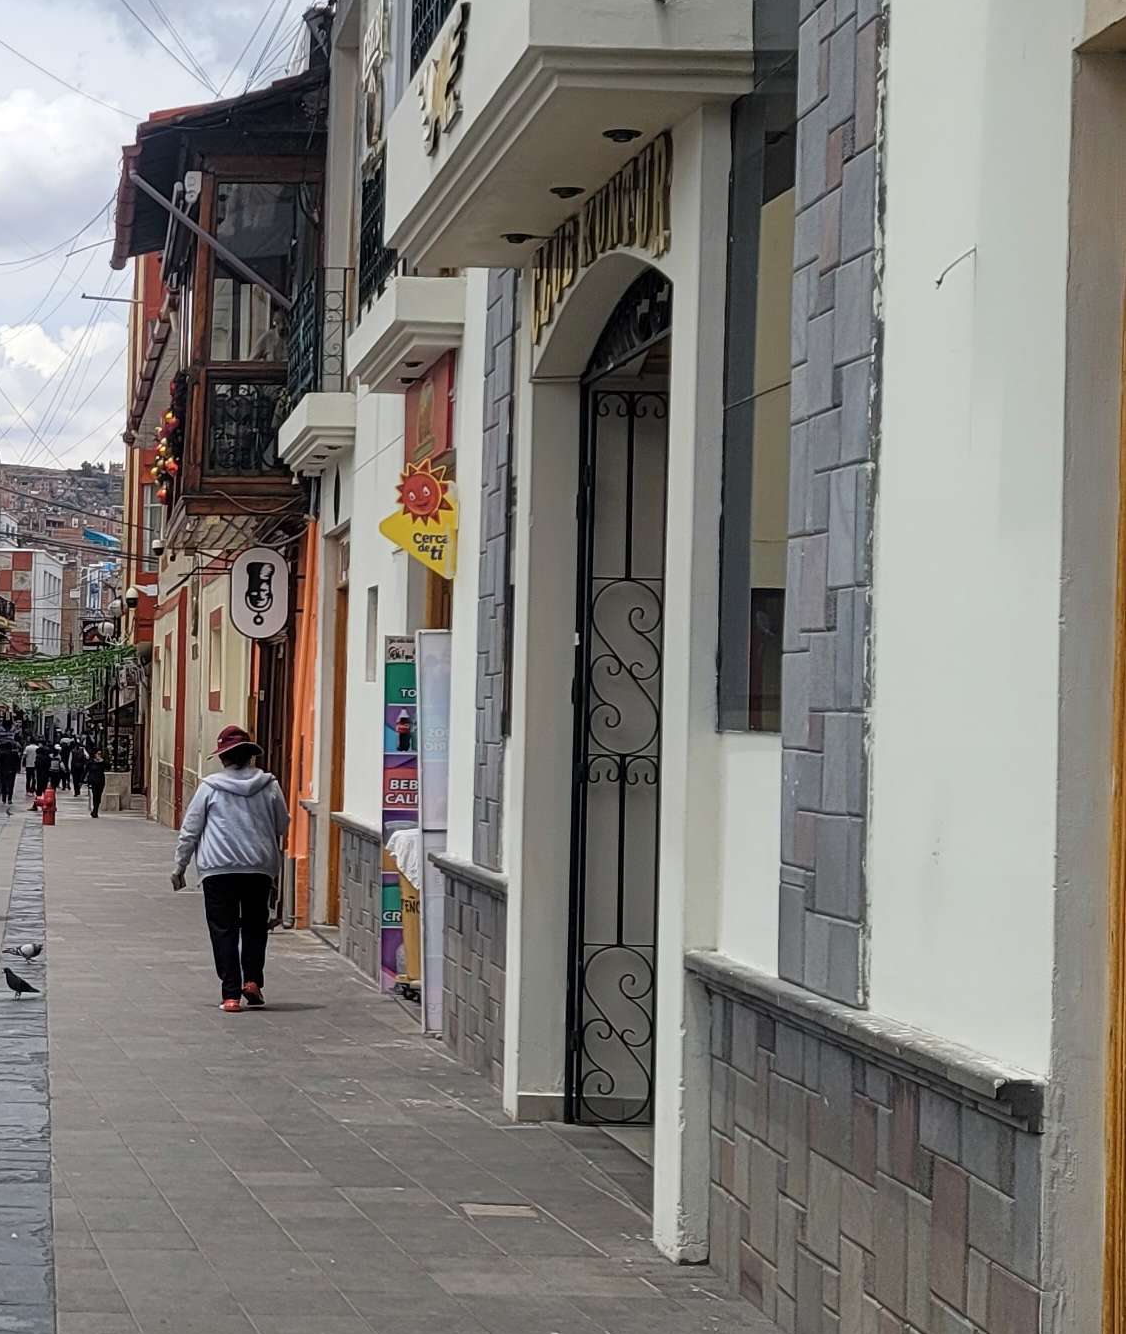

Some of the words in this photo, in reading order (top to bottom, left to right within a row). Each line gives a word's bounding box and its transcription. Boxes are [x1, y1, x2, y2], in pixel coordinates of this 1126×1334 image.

[530, 217, 578, 346] CLUB
[417, 543, 430, 553] de
[430, 544, 444, 561] ti
[389, 779, 419, 791] BEB
